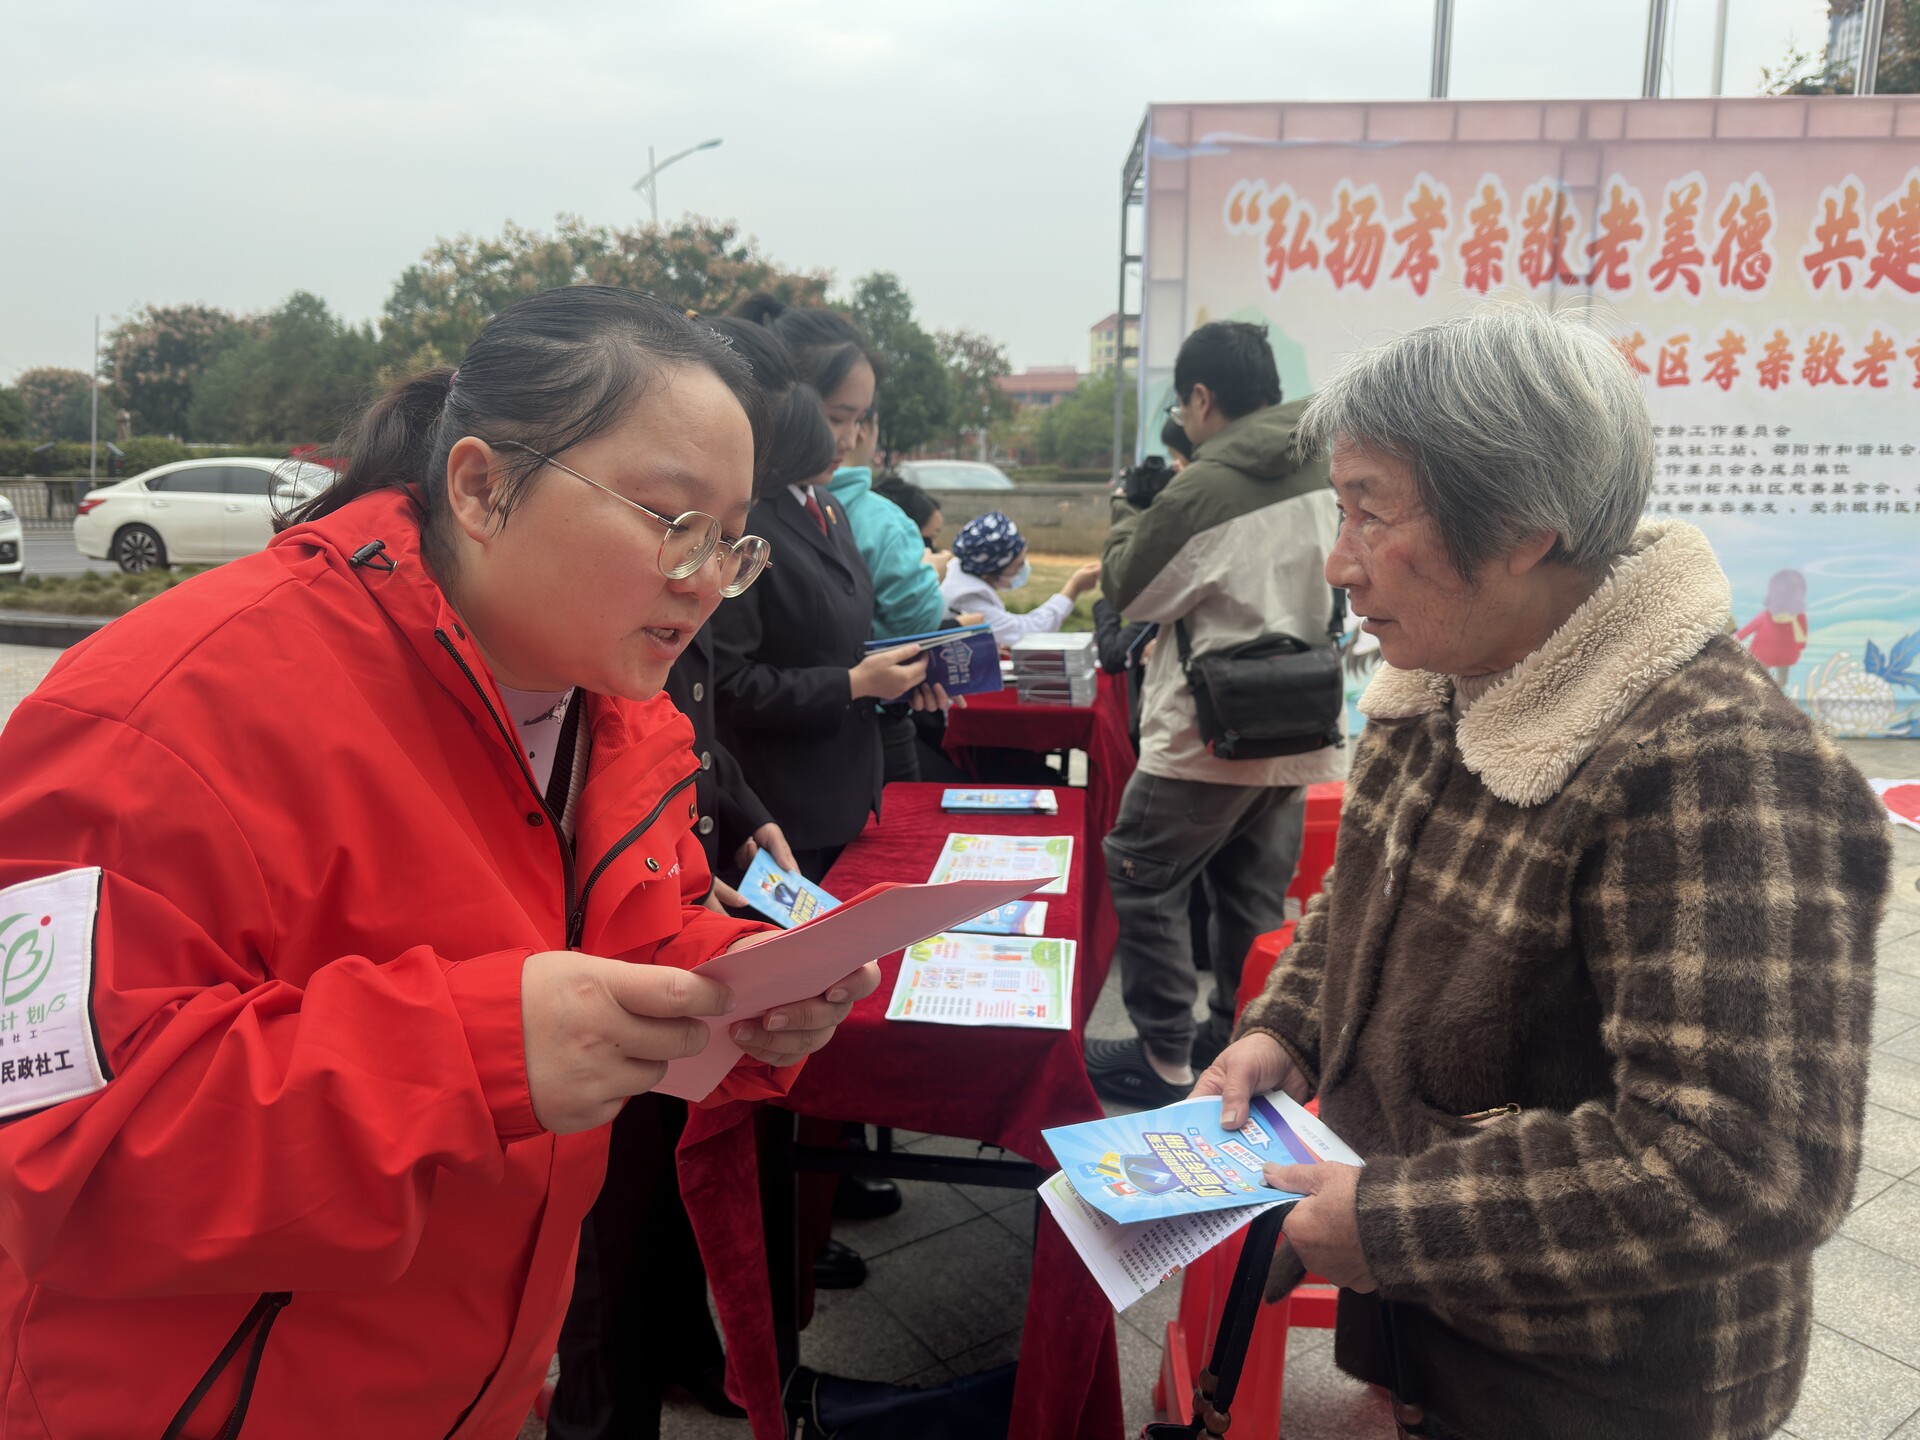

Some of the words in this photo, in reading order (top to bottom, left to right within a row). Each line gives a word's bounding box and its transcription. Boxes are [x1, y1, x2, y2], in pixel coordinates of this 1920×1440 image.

[1229, 181, 1773, 298] “弘扬孝亲敬老美德
[1654, 443, 1920, 457] 政社工站、邵阳市和谐社会
[1, 1049, 74, 1084] 民政社工
